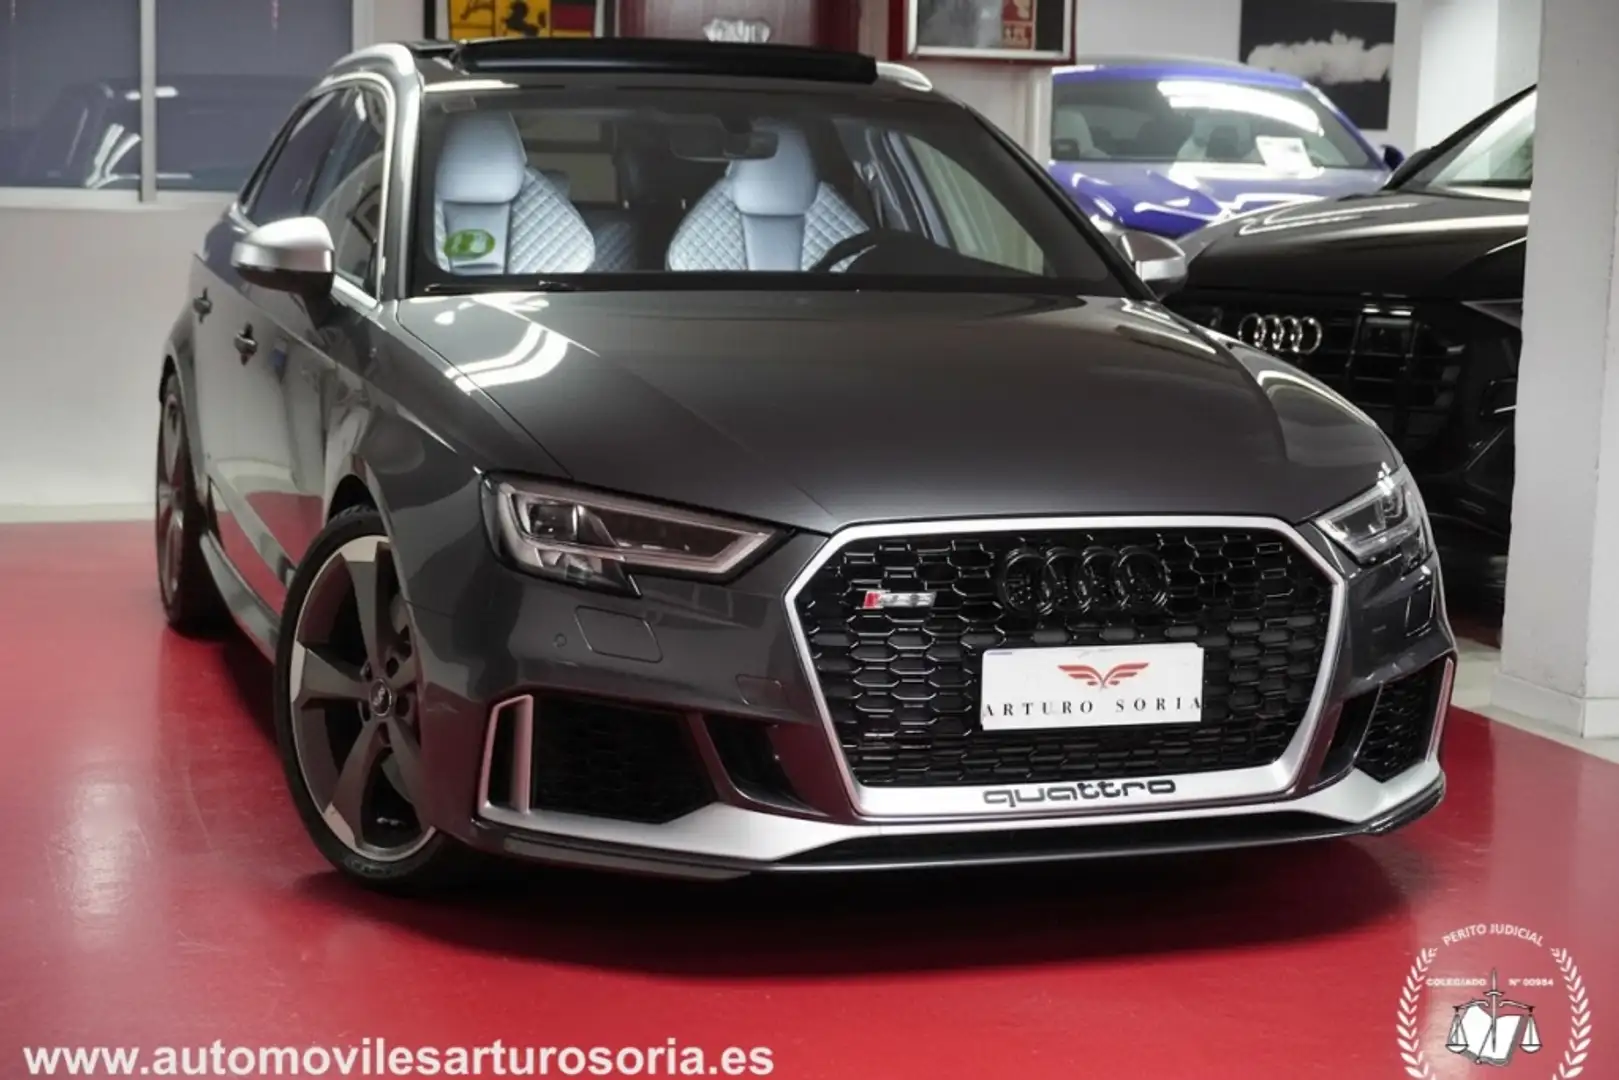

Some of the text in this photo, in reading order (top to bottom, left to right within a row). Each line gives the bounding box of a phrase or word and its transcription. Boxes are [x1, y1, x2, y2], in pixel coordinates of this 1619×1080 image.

[983, 696, 1202, 717] ARTURO SORIA
[983, 779, 1176, 808] quattro
